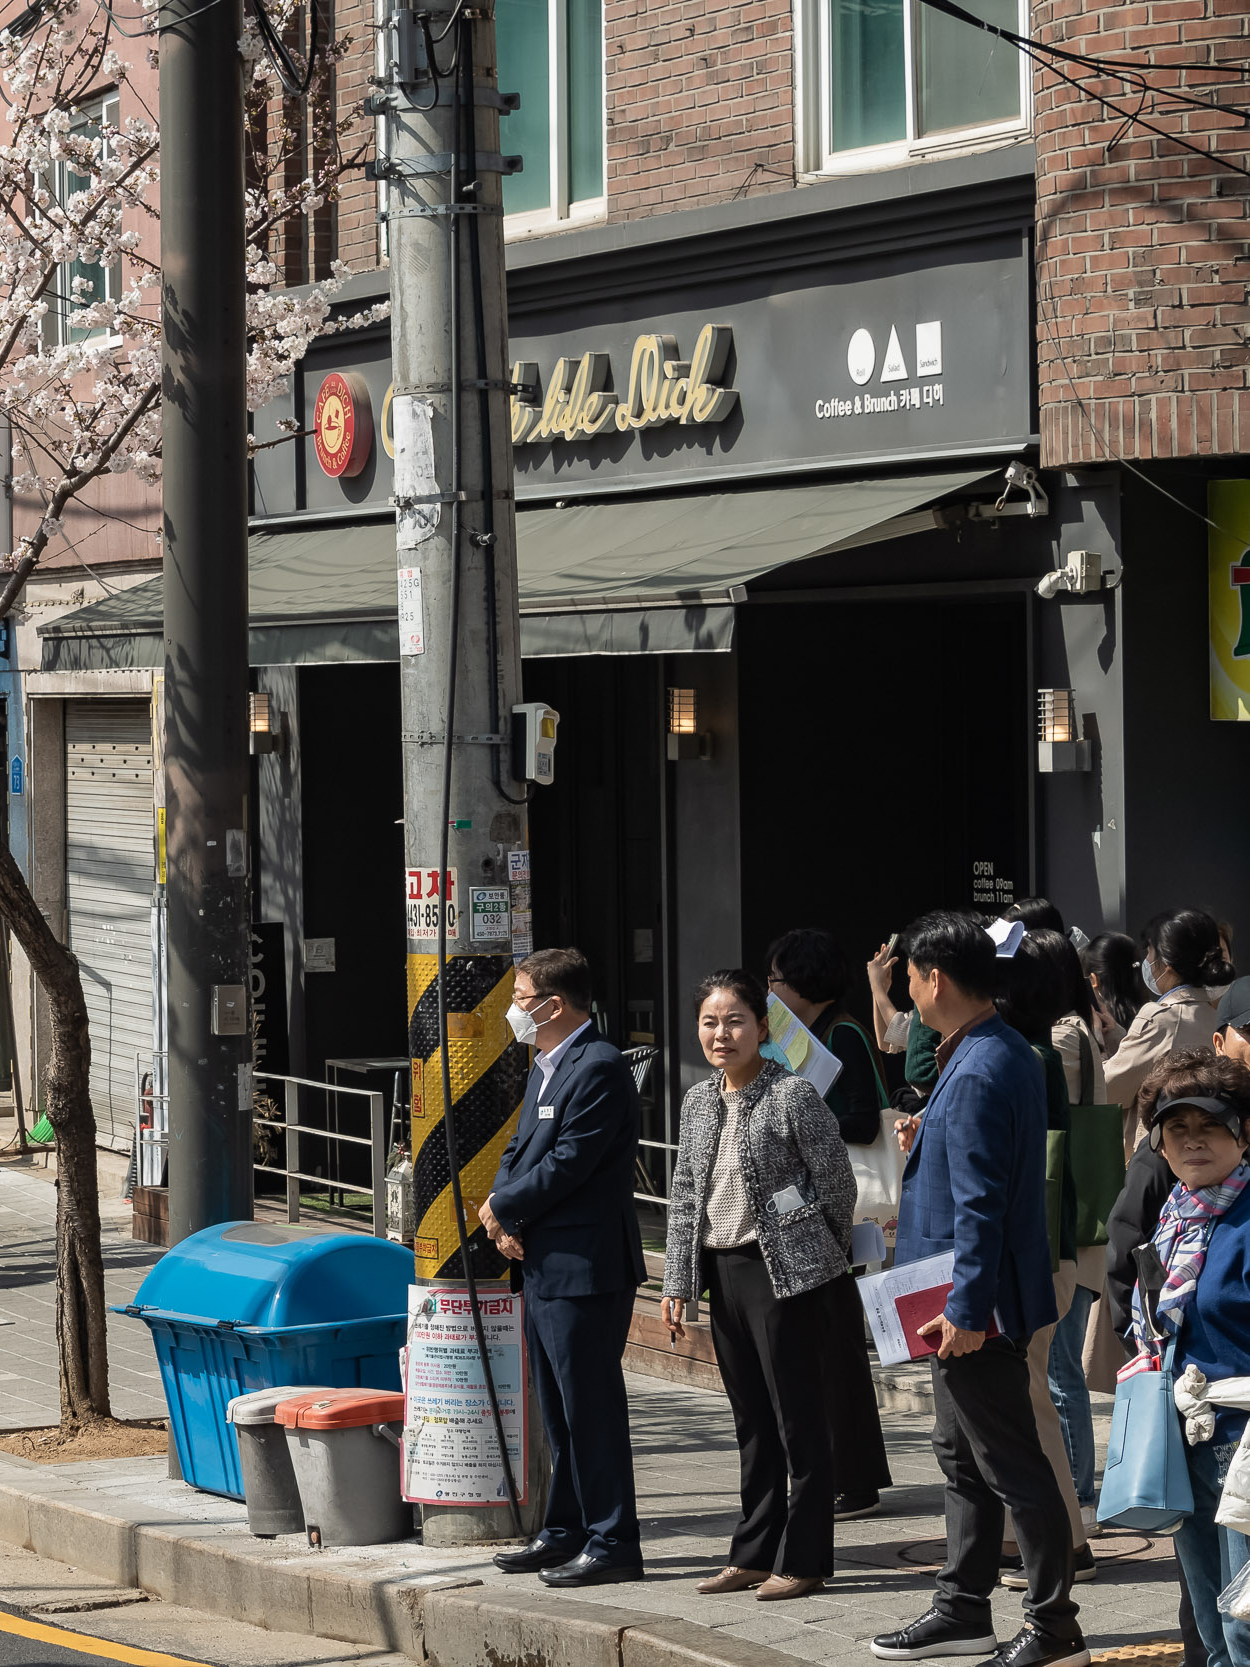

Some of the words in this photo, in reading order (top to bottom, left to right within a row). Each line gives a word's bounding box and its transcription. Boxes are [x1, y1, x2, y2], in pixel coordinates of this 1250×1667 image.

[616, 324, 730, 432] Dich
[316, 384, 329, 423] CAFE
[337, 383, 351, 420] DICH
[815, 398, 853, 419] Coffee
[854, 396, 863, 415] &
[864, 390, 898, 414] Brunch
[899, 387, 921, 409] 카페
[337, 432, 351, 465] Coffee
[973, 861, 994, 876] OPEN
[973, 877, 994, 889] coffee
[995, 878, 1014, 890] 09am
[973, 891, 995, 903] brunch
[996, 891, 1014, 903] 11am
[476, 902, 507, 912] 구의2동
[482, 914, 502, 925] 032
[444, 1333, 467, 1341] 과태료가
[444, 1399, 463, 1407] 버리는
[466, 1417, 483, 1425] 주세요
